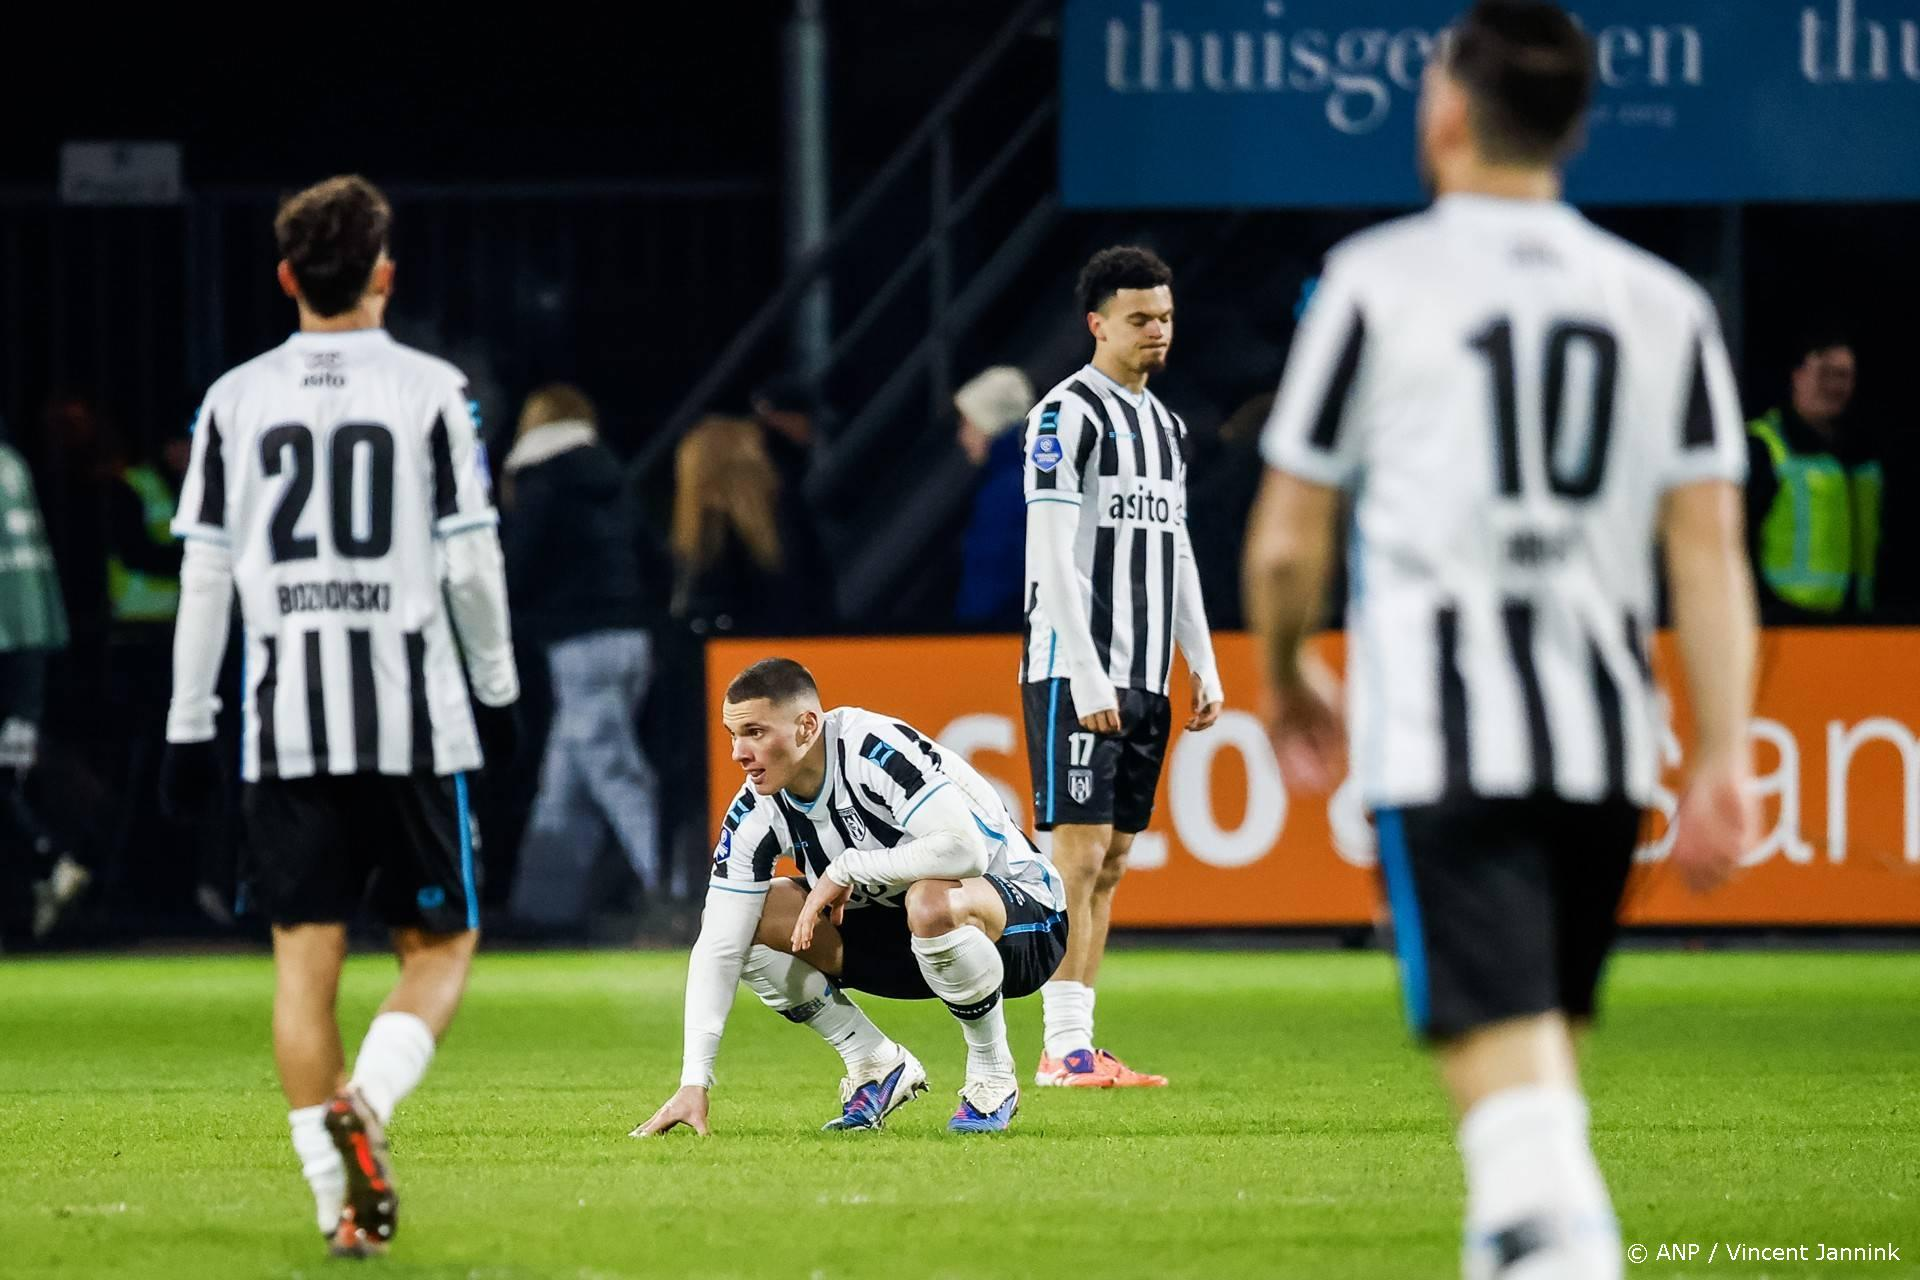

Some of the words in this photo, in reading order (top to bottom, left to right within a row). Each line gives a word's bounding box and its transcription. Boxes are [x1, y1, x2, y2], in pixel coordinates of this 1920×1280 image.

[1467, 315, 1617, 500] 10
[260, 421, 394, 563] 20
[1109, 484, 1169, 523] asito
[1068, 731, 1096, 767] 17
